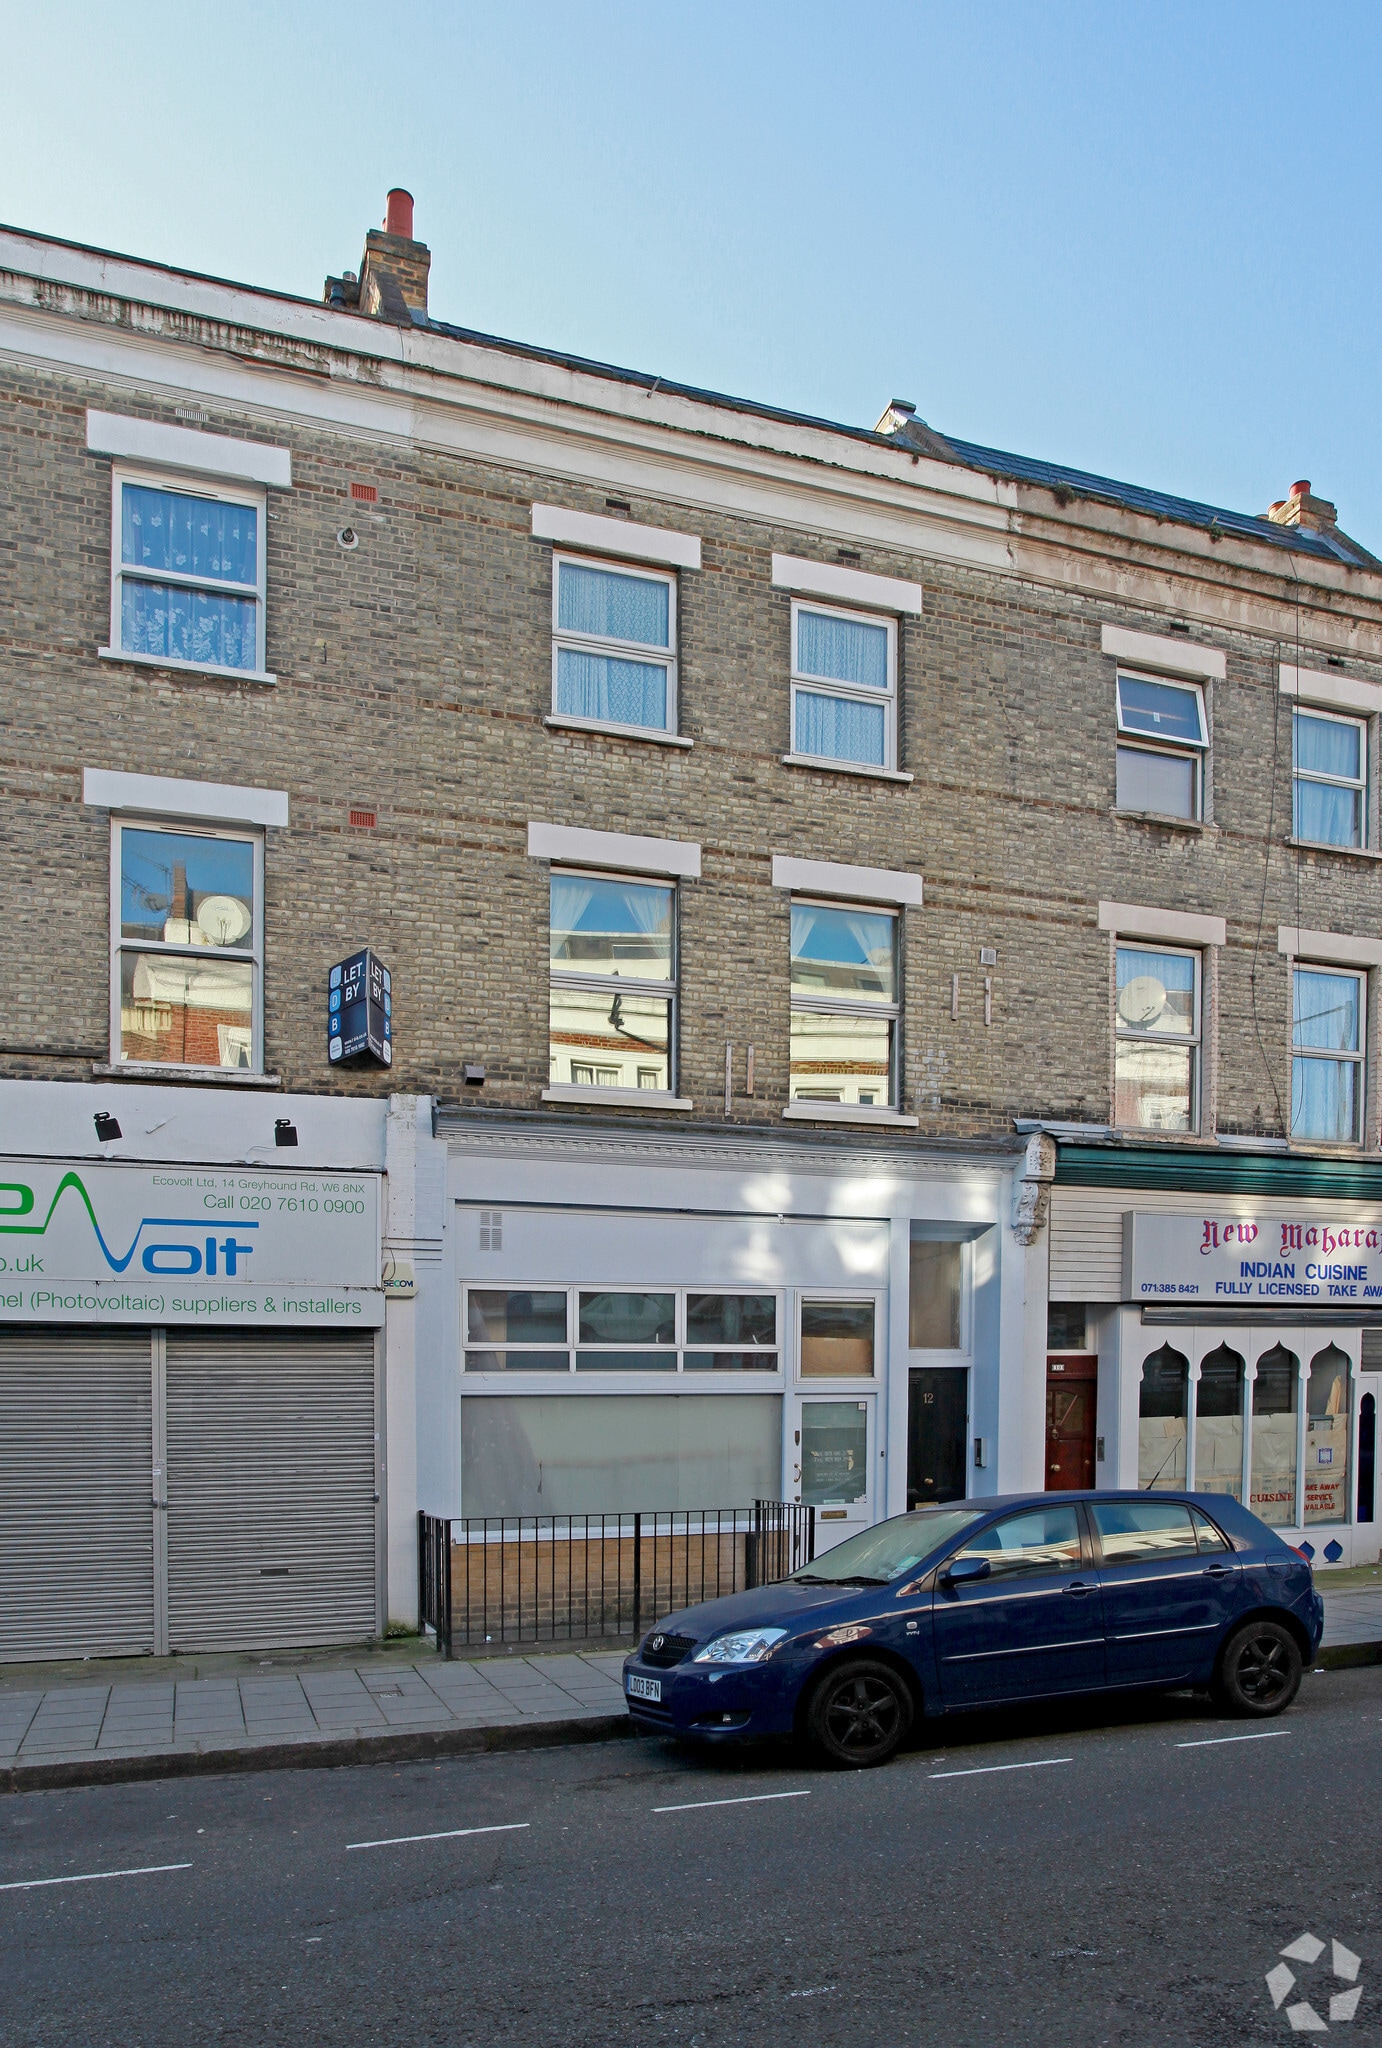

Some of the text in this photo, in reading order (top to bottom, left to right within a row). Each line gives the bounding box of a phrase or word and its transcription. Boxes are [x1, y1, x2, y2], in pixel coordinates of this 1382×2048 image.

[344, 962, 363, 984] LET
[371, 961, 382, 984] LET
[345, 982, 360, 1001] BY
[373, 982, 381, 1001] BY
[152, 1175, 365, 1193] Ecovolt Ltd, 14 Greyhound Rd, W6 8NX
[203, 1194, 365, 1214] Call 020 7610 0900
[1200, 1220, 1259, 1255] New
[1240, 1261, 1368, 1281] INDIAN CUISINE
[383, 1279, 414, 1288] SECOM
[1178, 1284, 1199, 1294] 8421
[1215, 1281, 1253, 1294] FULLY
[1258, 1282, 1320, 1296] LICENSED
[1327, 1284, 1358, 1297] TAKE
[30, 1291, 165, 1313] (Photovoltaic)
[171, 1294, 258, 1315] suppliers
[264, 1297, 277, 1313] &
[283, 1297, 362, 1314] installers
[923, 1392, 934, 1404] 12
[1319, 1482, 1340, 1491] AWAY
[1250, 1492, 1294, 1504] CUISINE
[1306, 1493, 1333, 1501] SERVICE
[646, 1680, 660, 1698] BFN
